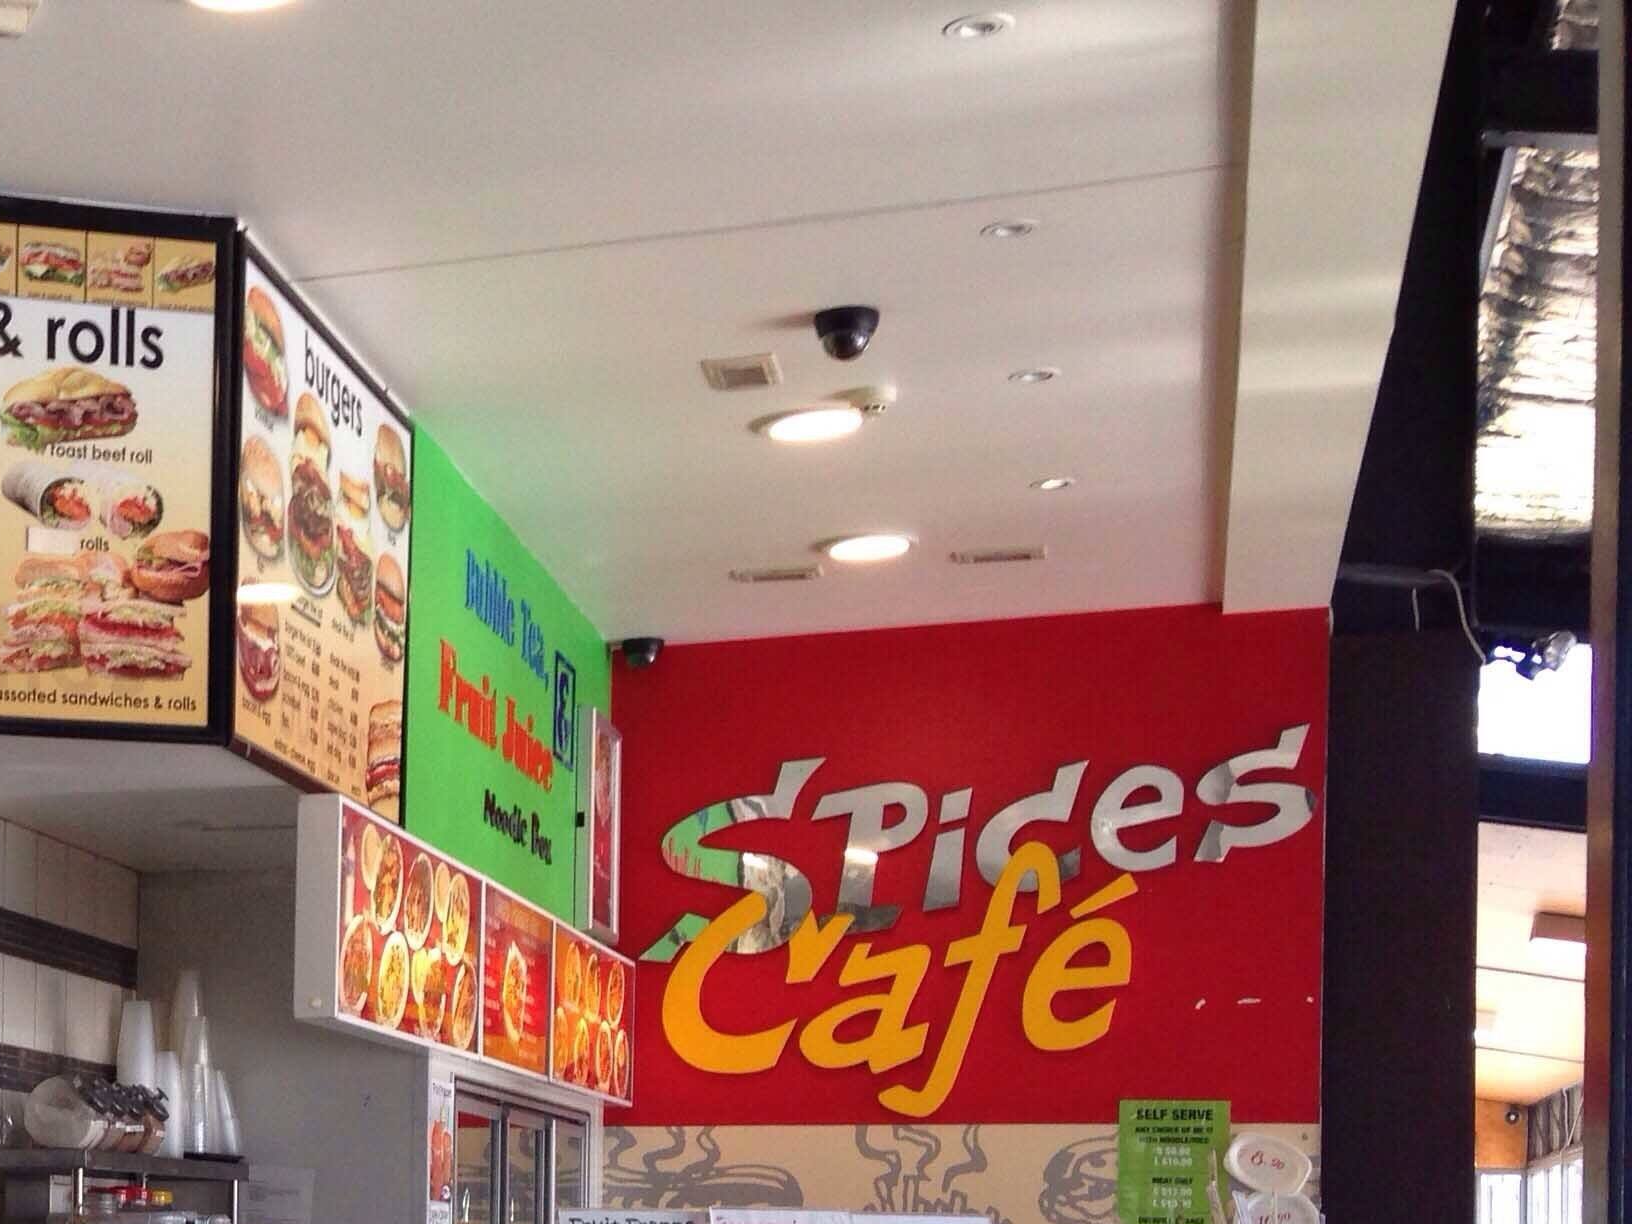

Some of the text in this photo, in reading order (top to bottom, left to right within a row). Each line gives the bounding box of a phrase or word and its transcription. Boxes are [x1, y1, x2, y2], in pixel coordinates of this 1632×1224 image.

[45, 307, 166, 371] rolls
[304, 329, 363, 438] burgers
[50, 443, 153, 465] roast beef roll
[79, 536, 110, 553] rolls
[61, 691, 150, 710] sandwiches
[153, 695, 163, 710] &
[168, 696, 197, 712] rolls
[438, 637, 498, 750] Fruit
[501, 695, 554, 794] Juice
[483, 787, 554, 866] Noodle Box
[661, 841, 1139, 1118] Café
[1136, 1108, 1214, 1121] SELF SERVE
